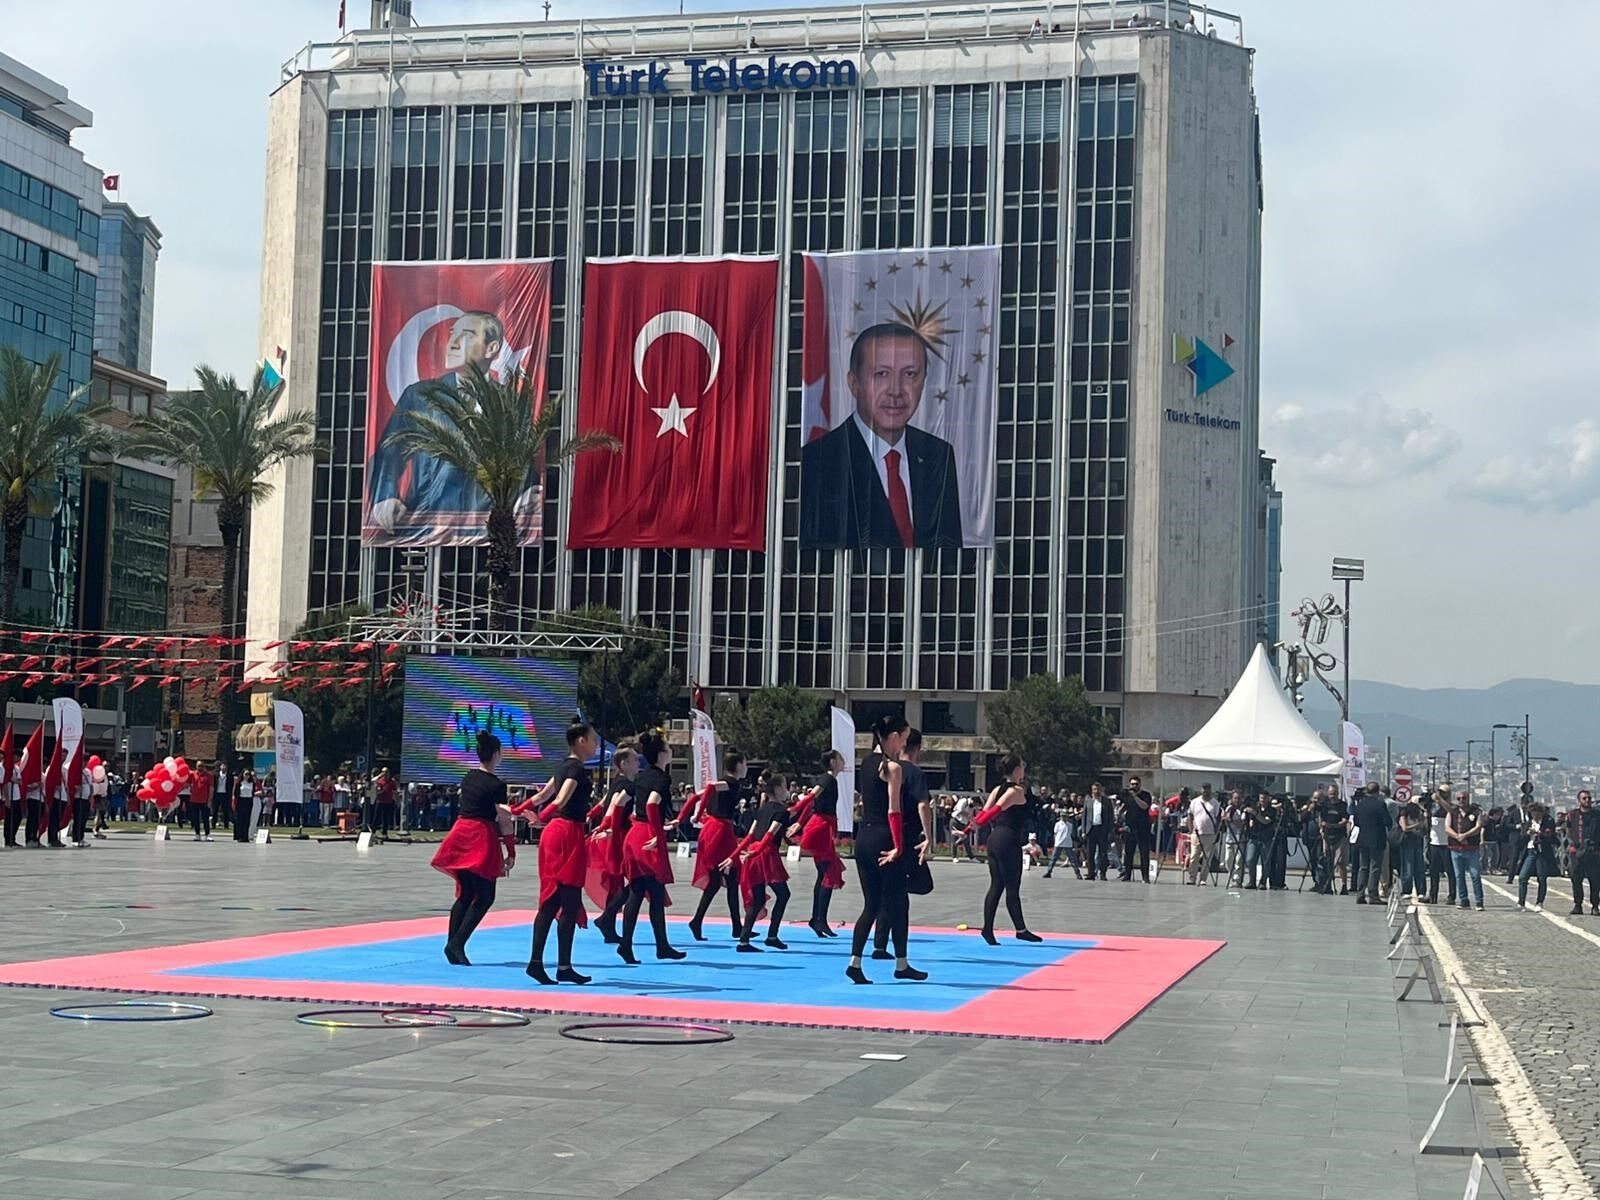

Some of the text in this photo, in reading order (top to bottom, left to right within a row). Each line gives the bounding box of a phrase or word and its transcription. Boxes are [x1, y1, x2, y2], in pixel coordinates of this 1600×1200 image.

[584, 55, 856, 96] Türk Telekom
[1166, 408, 1240, 430] Türk Telekom
